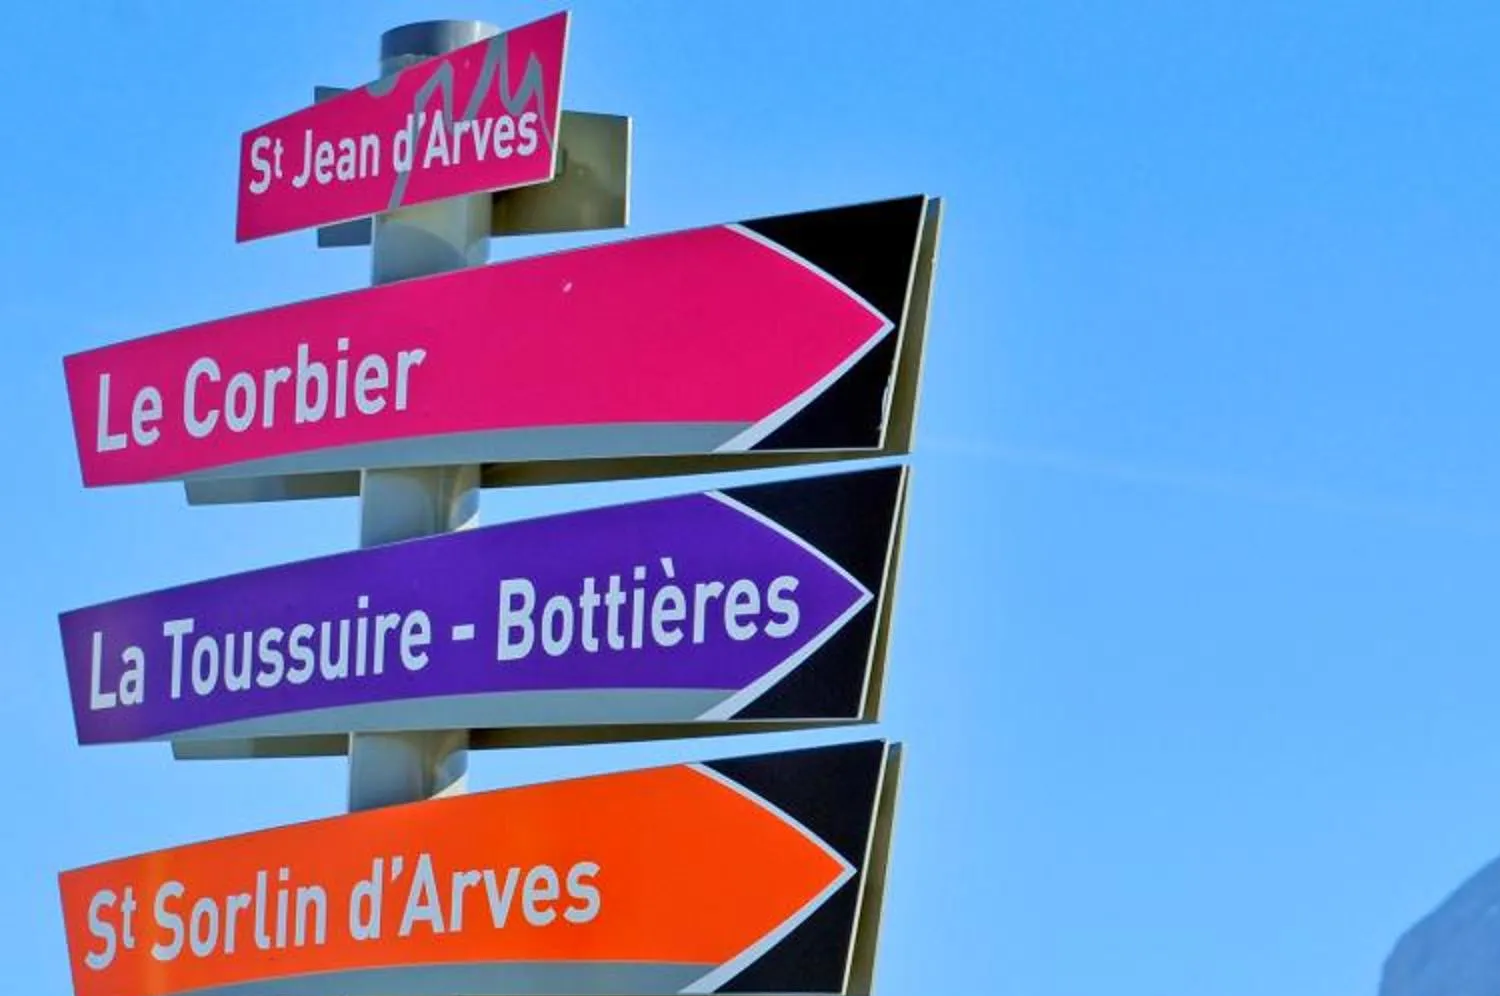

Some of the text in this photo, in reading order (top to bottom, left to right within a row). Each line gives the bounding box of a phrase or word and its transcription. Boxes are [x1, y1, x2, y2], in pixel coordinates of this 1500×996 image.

[249, 108, 538, 195] St Jean d'Arves
[97, 337, 427, 453] Le Corbier
[90, 557, 801, 711] La Toussuire - Bottières
[84, 853, 600, 970] St Sorlin d'Arves
